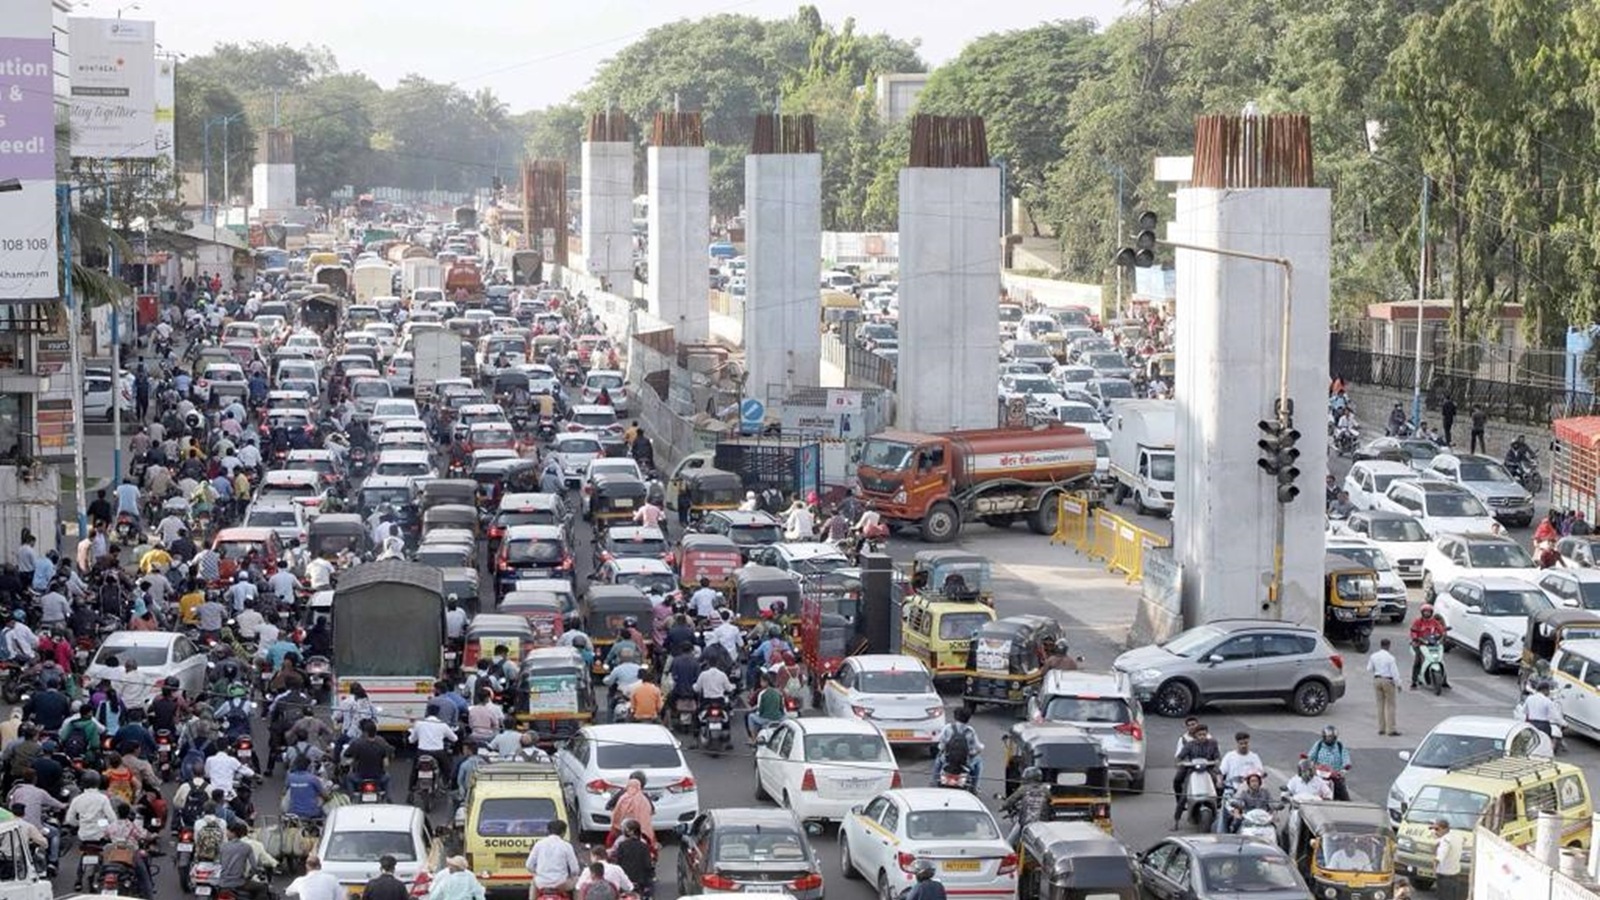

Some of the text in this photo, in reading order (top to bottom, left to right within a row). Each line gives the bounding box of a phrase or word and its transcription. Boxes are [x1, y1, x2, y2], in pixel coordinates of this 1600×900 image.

[10, 84, 23, 101] &
[26, 237, 48, 251] 108
[484, 838, 529, 848] SCHOOL
